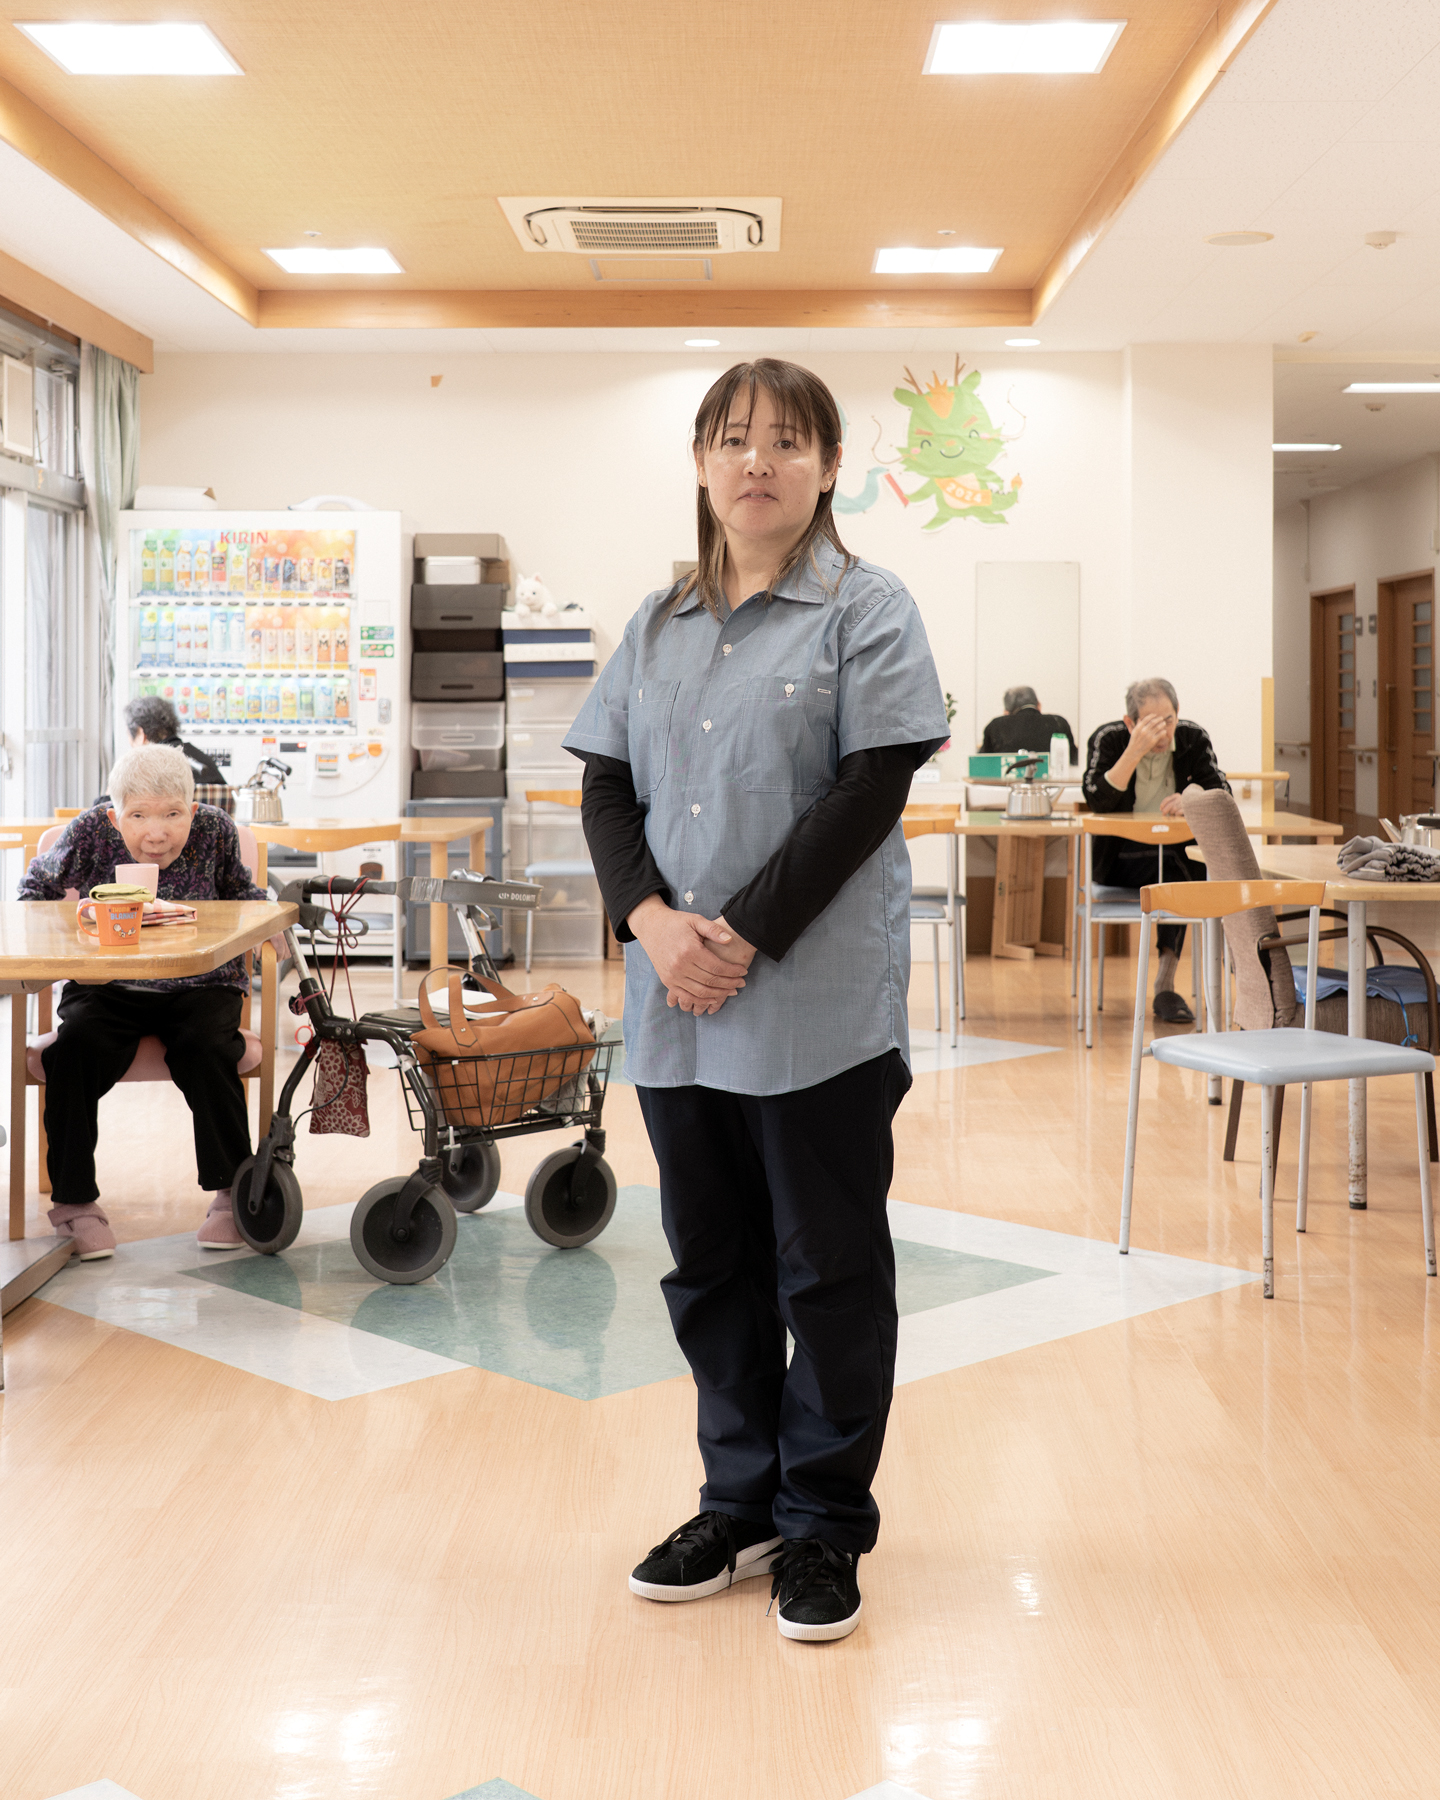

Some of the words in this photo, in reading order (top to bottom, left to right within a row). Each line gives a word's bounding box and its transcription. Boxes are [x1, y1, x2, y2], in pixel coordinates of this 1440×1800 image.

[946, 483, 982, 503] 2024
[220, 531, 268, 544] KIRIN
[111, 912, 137, 920] BLANKET
